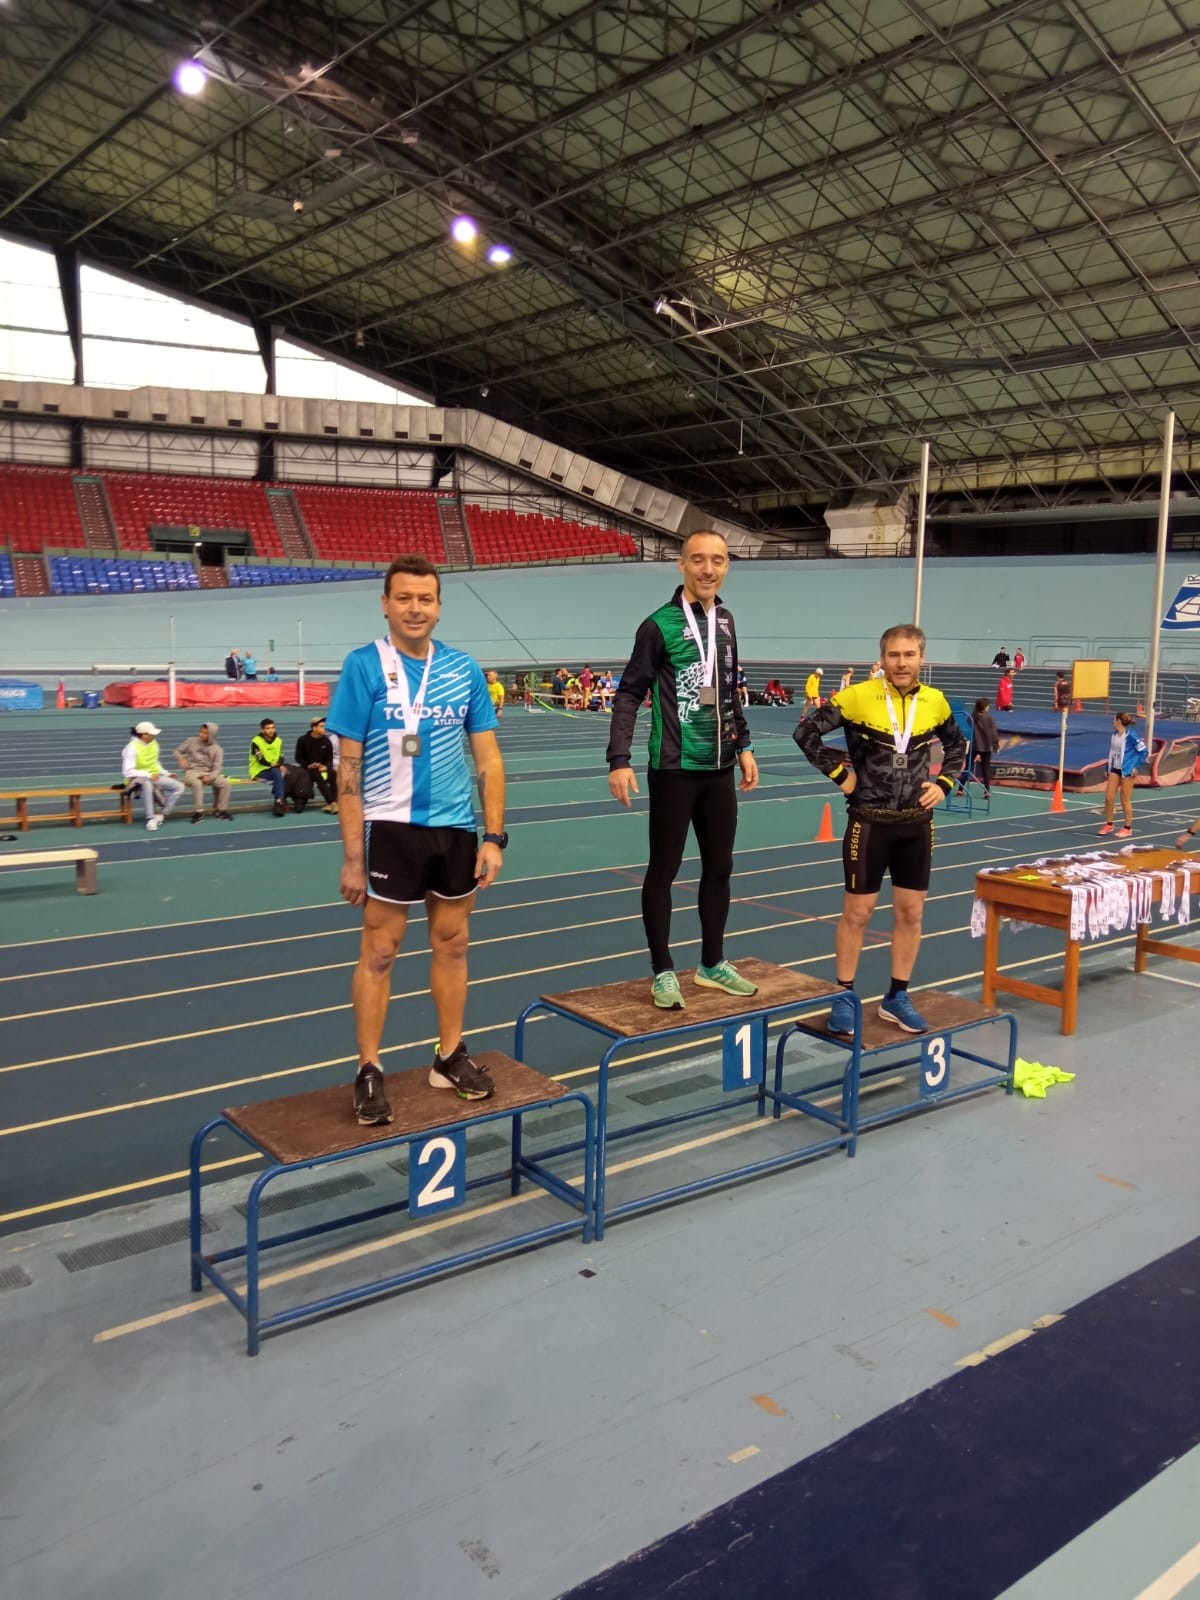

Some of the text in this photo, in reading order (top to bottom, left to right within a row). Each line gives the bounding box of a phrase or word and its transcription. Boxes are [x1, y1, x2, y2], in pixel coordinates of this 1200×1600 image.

[383, 704, 455, 720] TOOSA
[735, 1024, 752, 1080] 1
[925, 1037, 946, 1087] 3
[417, 1137, 457, 1208] 2
